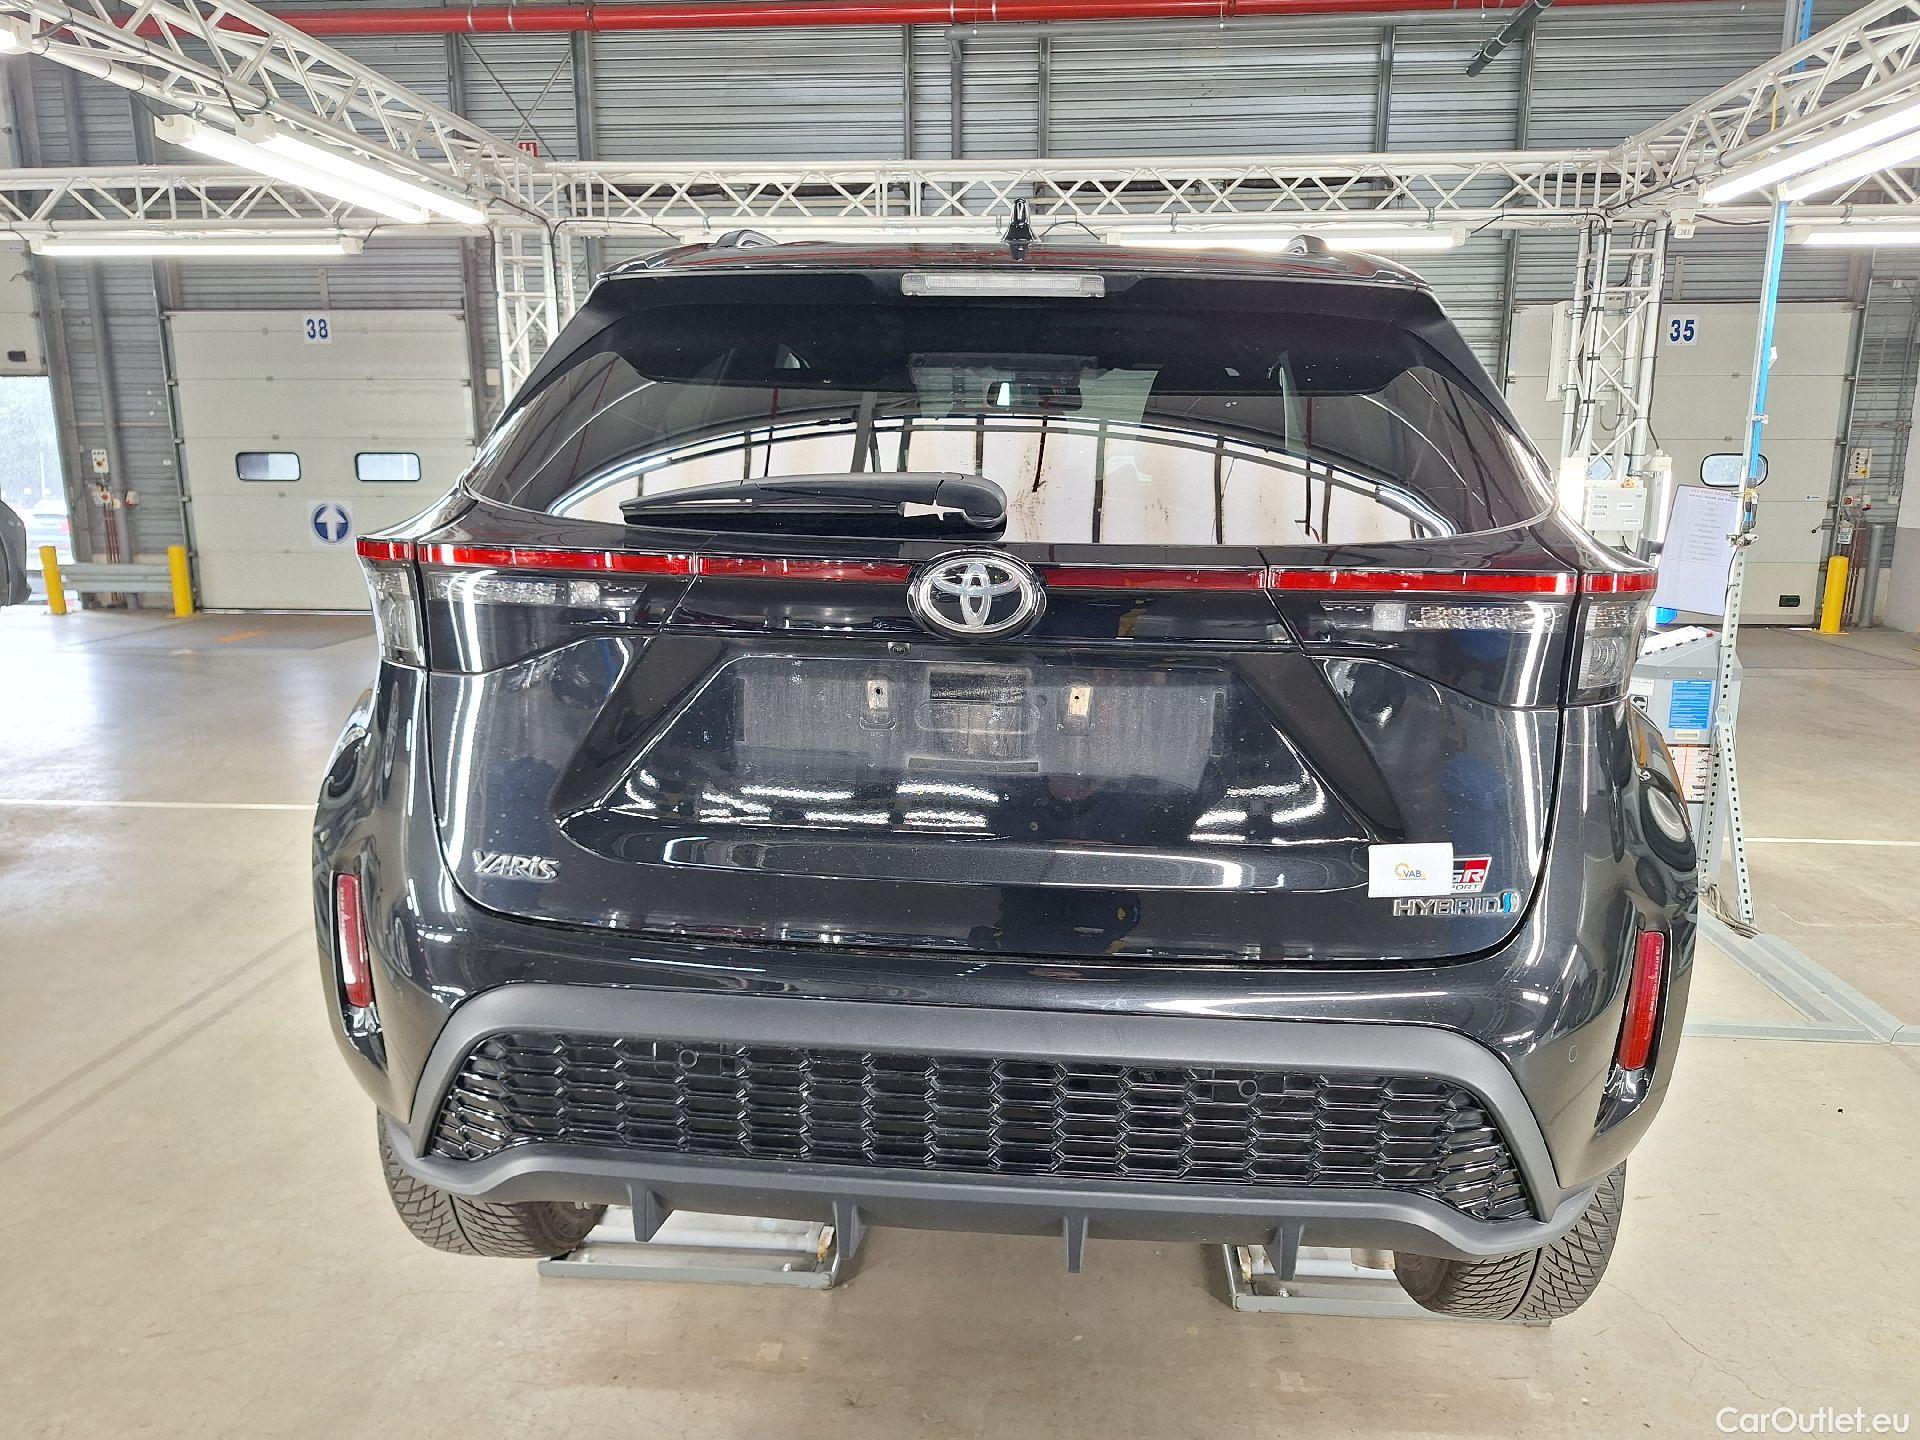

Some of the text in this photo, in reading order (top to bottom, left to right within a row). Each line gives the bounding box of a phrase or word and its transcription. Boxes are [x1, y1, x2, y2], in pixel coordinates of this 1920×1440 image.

[306, 319, 328, 339] 38
[1670, 319, 1695, 341] 35
[1403, 869, 1422, 878] VAB
[1393, 897, 1502, 917] HYBRID
